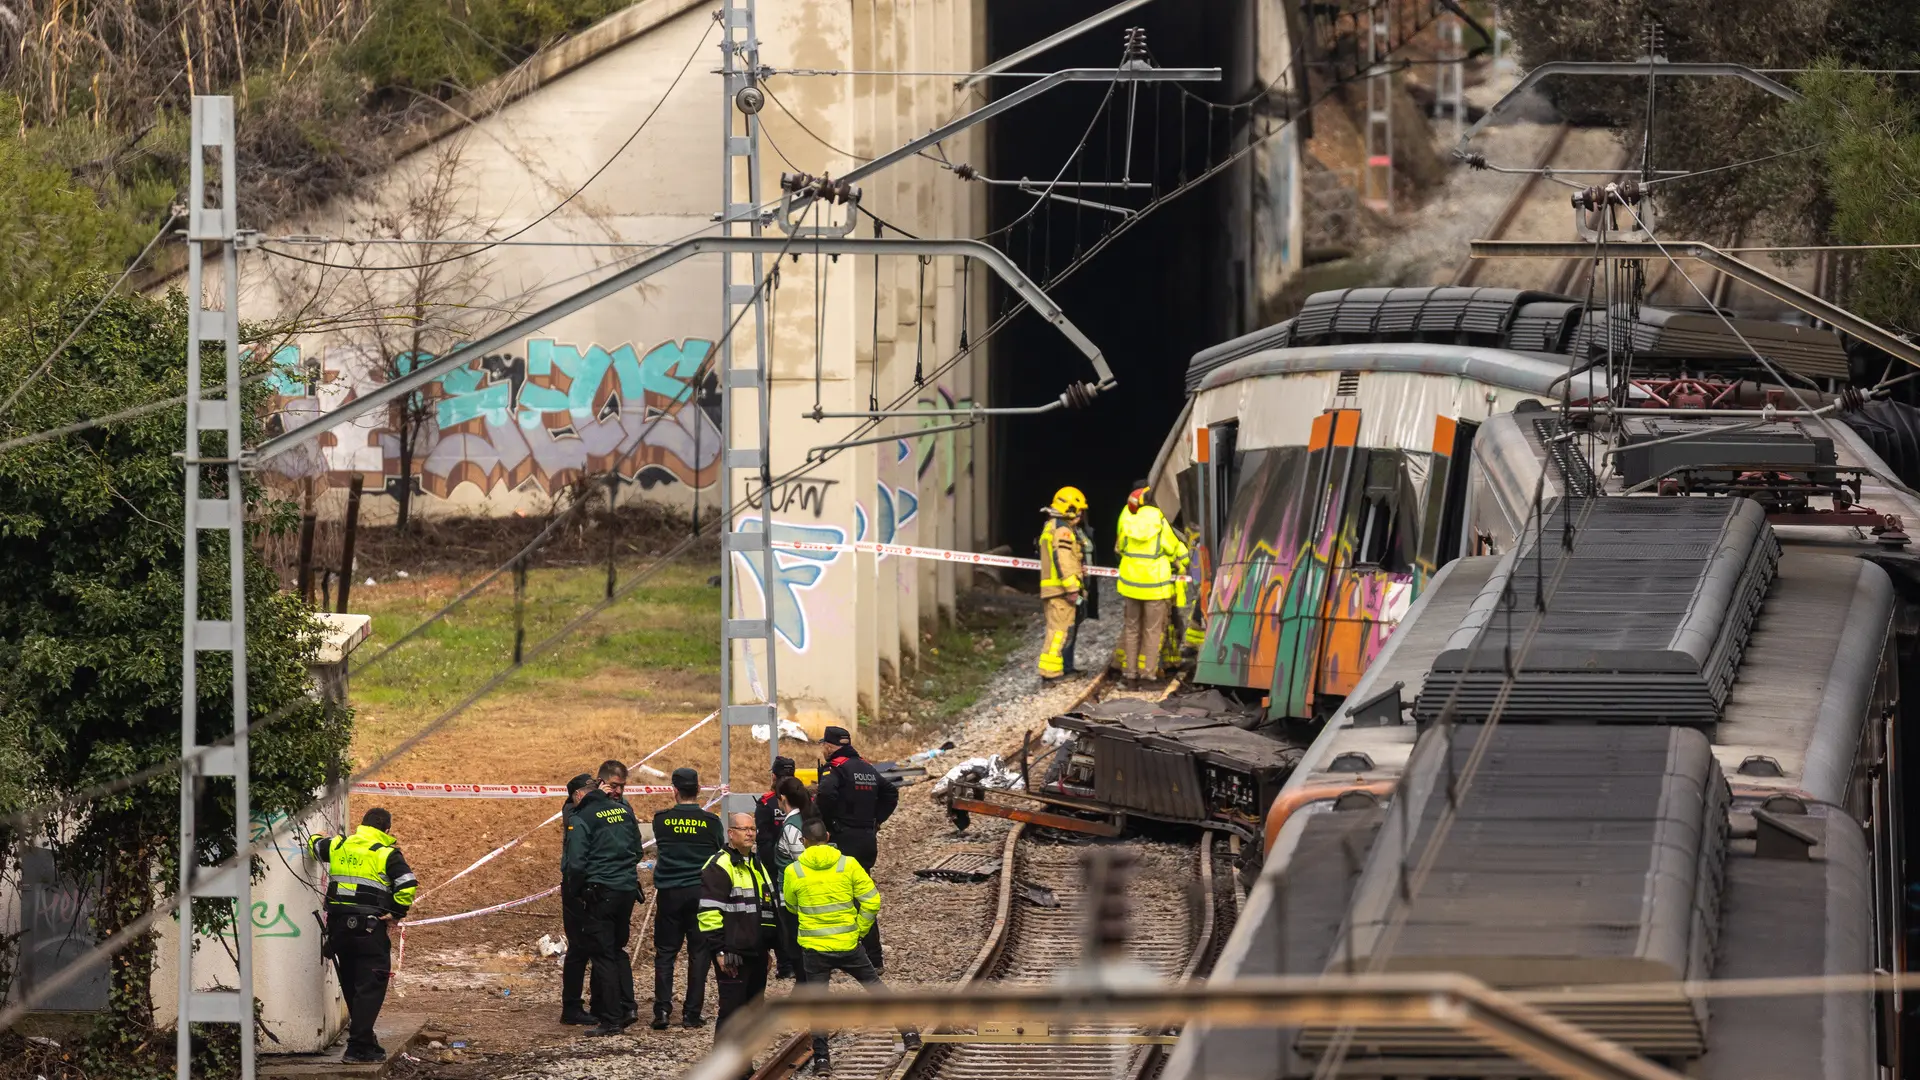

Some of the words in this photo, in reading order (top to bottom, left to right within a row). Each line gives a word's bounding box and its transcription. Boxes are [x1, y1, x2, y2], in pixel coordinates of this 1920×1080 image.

[596, 807, 628, 818] GUARDIA
[607, 815, 624, 824] CIVIL
[664, 818, 707, 828] GUARDIA
[674, 826, 697, 834] CIVIL
